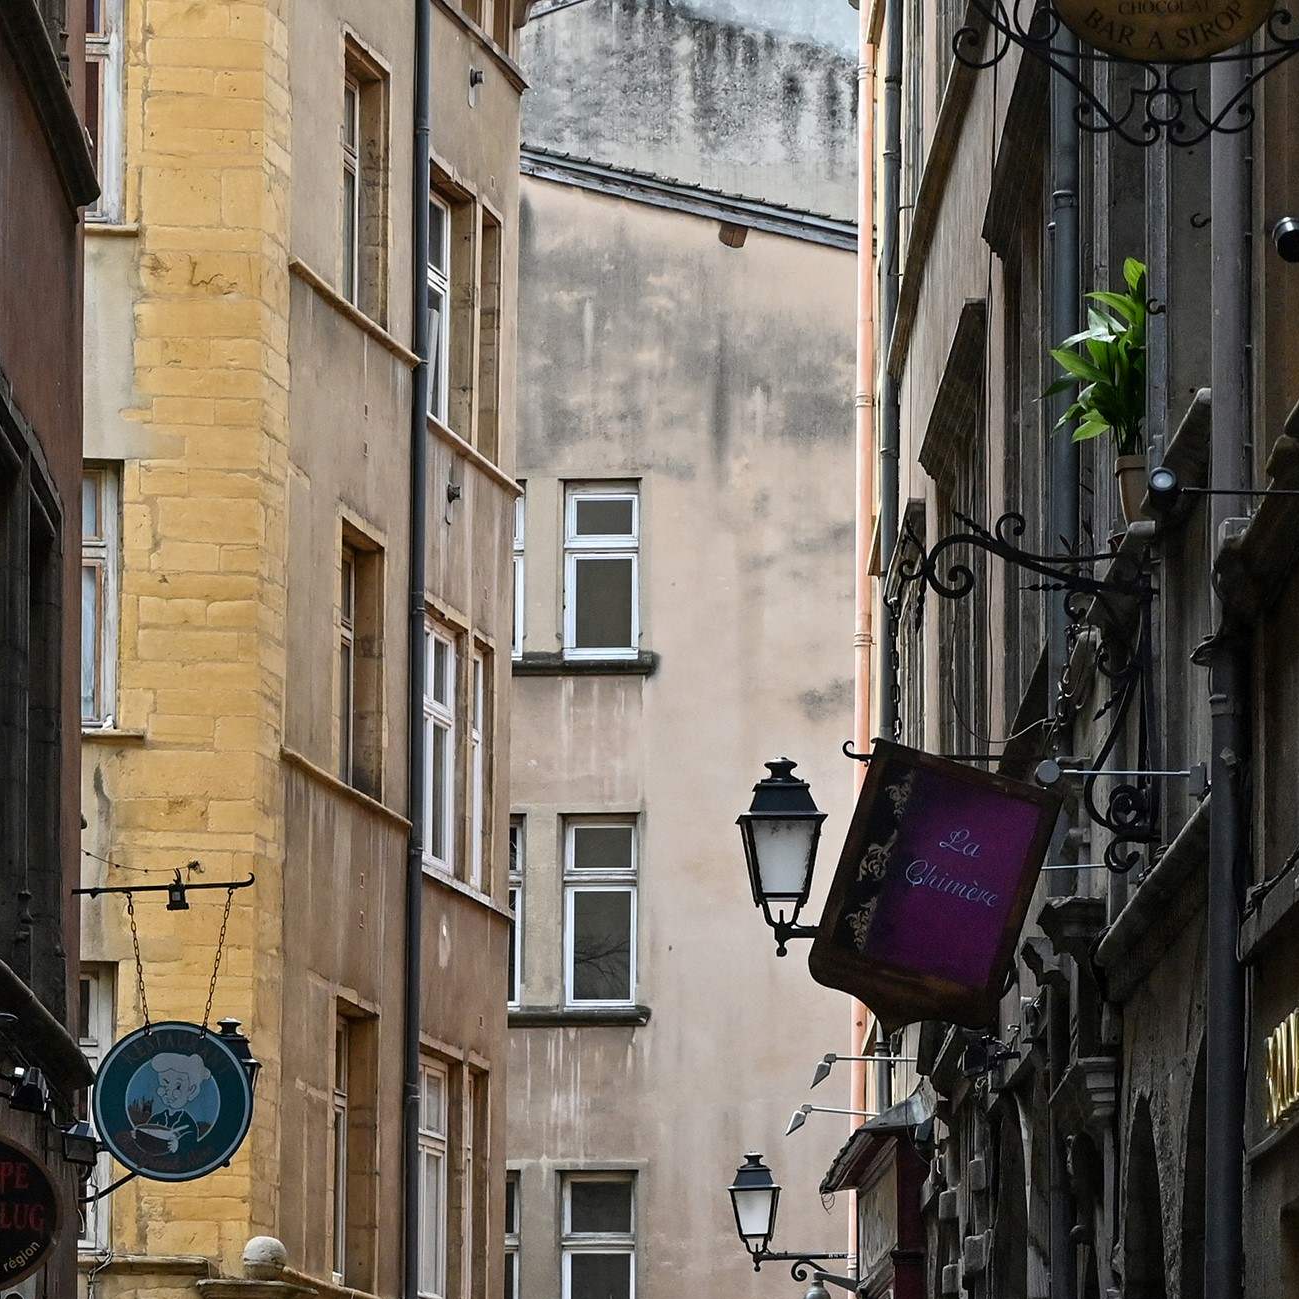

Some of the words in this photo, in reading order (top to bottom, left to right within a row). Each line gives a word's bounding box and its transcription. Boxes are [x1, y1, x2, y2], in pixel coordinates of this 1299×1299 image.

[1085, 7, 1135, 46] BAR
[1148, 31, 1164, 50] A
[1176, 1, 1243, 47] SIROP
[939, 828, 981, 858] La
[905, 859, 998, 907] Chimère
[3, 1240, 42, 1272] région
